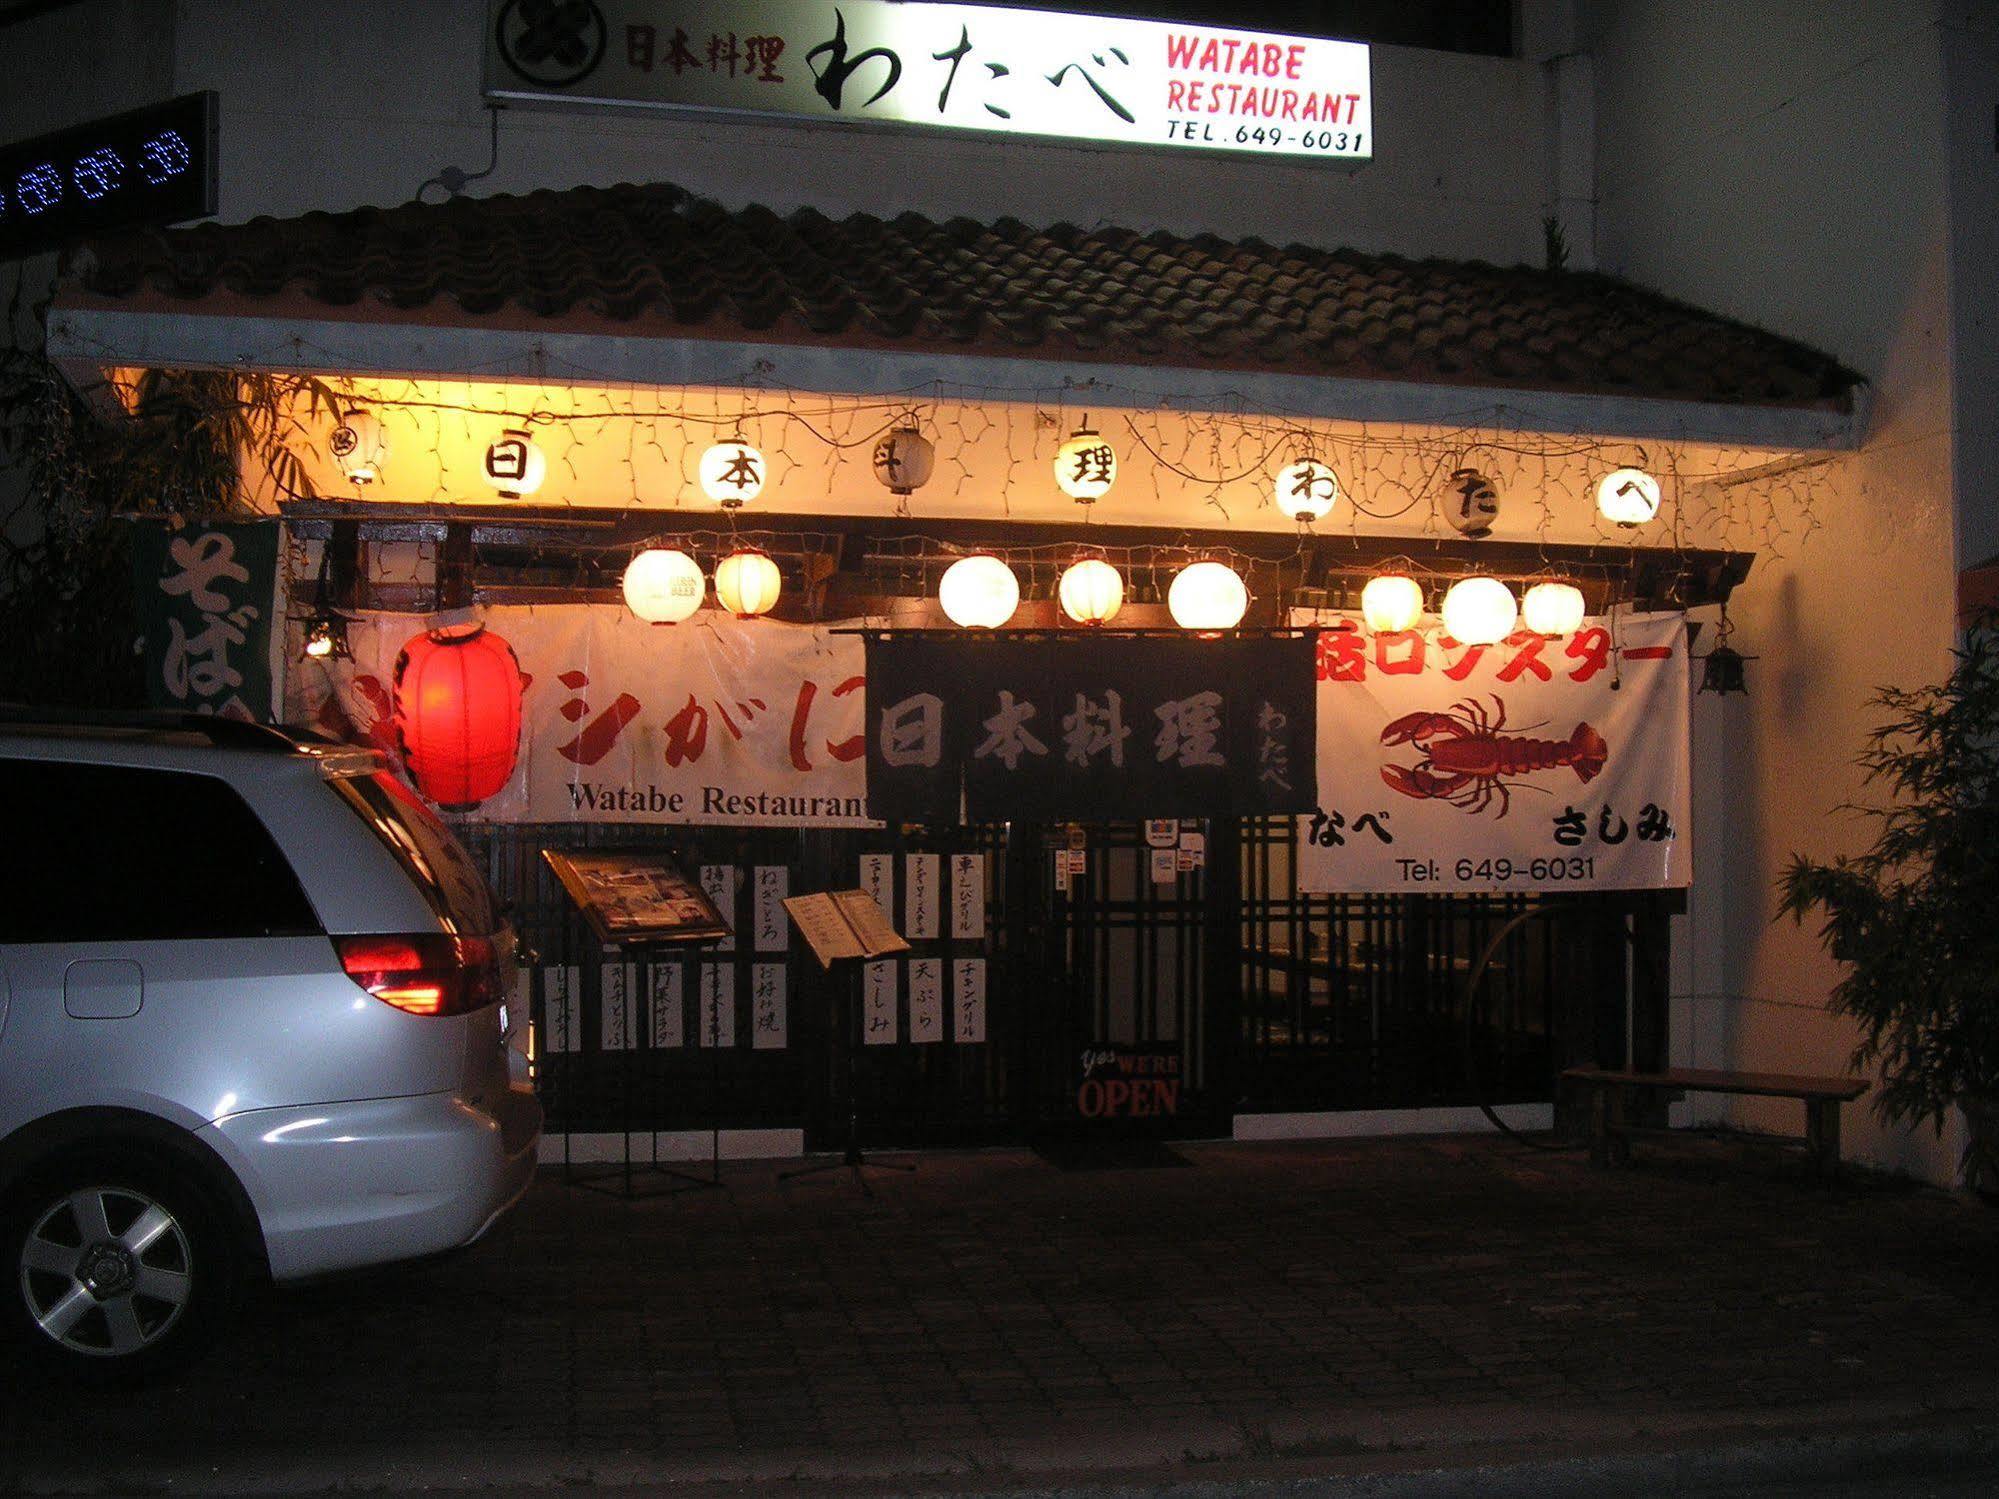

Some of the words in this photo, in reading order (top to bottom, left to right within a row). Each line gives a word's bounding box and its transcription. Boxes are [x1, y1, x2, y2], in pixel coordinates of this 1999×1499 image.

[625, 24, 785, 82] 日本料理
[805, 8, 1136, 125] わたべ
[1167, 35, 1307, 80] WATABE
[1167, 80, 1361, 126] RESTAURANT
[1234, 125, 1364, 154] 649-6031
[485, 440, 527, 480] 日
[716, 450, 760, 489] 本
[1072, 444, 1114, 484] 理
[1290, 473, 1337, 500] わ
[1456, 478, 1496, 518] た
[880, 688, 1226, 770] 日本料理
[568, 785, 683, 814] Watabe
[702, 786, 867, 818] Restauran
[1308, 807, 1393, 846] なべ
[1552, 801, 1677, 846] さしみ
[1396, 859, 1440, 882] Tel:
[1455, 857, 1594, 882] 649-6031
[1077, 1080, 1181, 1119] OPEN
